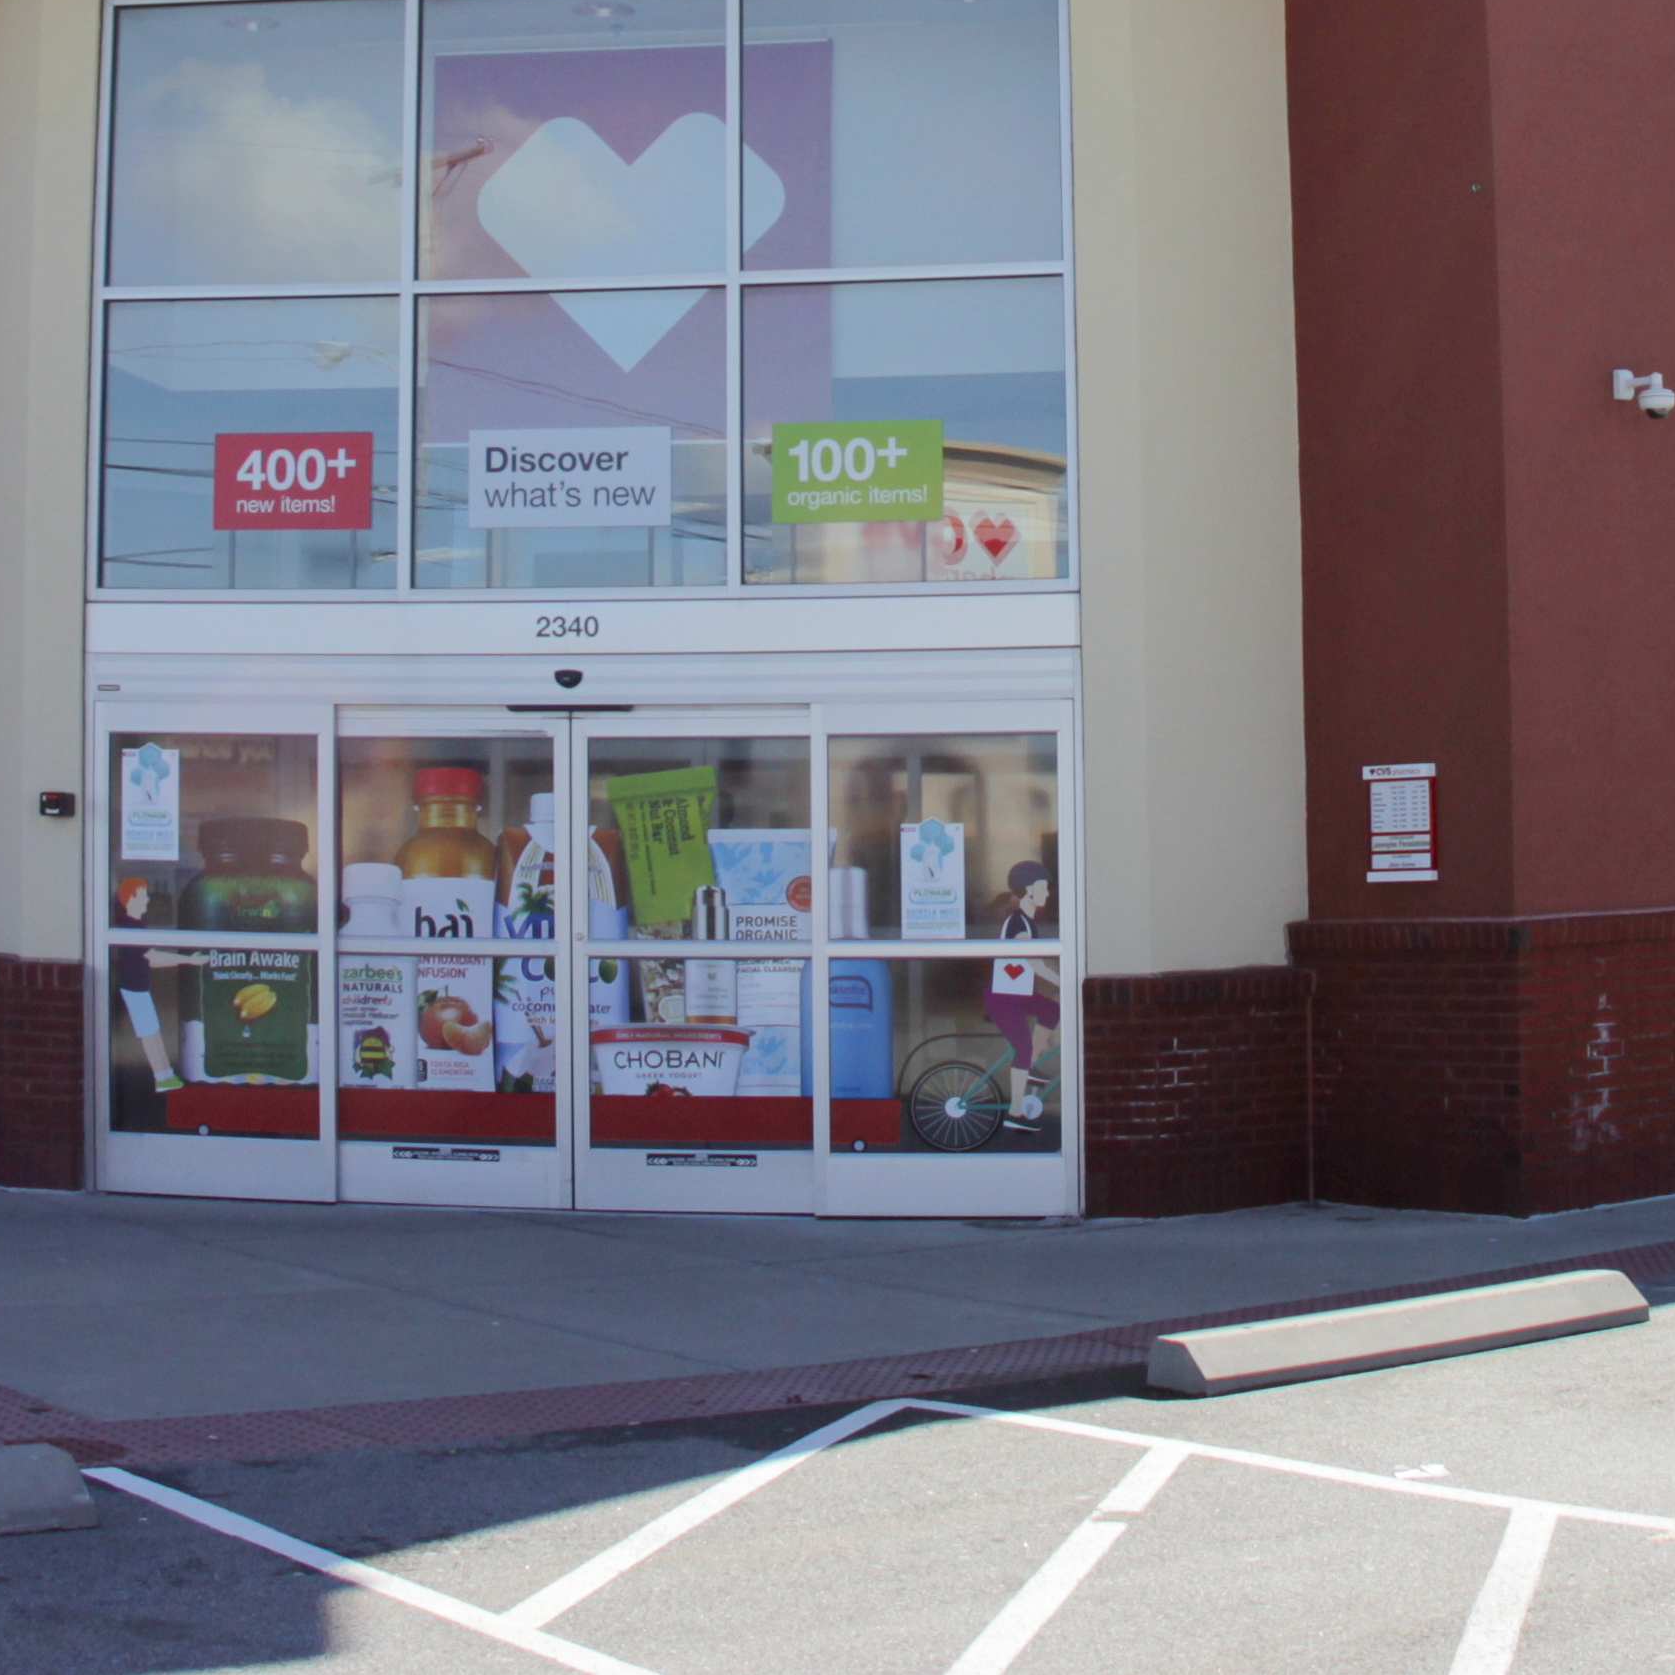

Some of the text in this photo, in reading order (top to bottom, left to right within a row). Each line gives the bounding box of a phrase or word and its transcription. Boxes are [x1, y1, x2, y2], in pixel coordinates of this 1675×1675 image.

[485, 446, 629, 473] Discover
[788, 437, 908, 482] 100+
[236, 448, 357, 491] 400+
[484, 481, 656, 508] what's new
[787, 485, 927, 510] organic items!
[236, 495, 335, 513] new items!
[536, 616, 599, 637] 2340
[1376, 767, 1391, 776] CVS
[735, 916, 798, 927] PROMISE
[735, 929, 798, 940] ORGANIC
[209, 949, 300, 968] Brain Awake
[343, 963, 403, 981] zarbee's
[418, 968, 466, 979] NFUSION
[343, 982, 403, 993] NATURALS
[512, 1002, 611, 1014] cocon ater
[614, 1050, 724, 1069] CHOBANI
